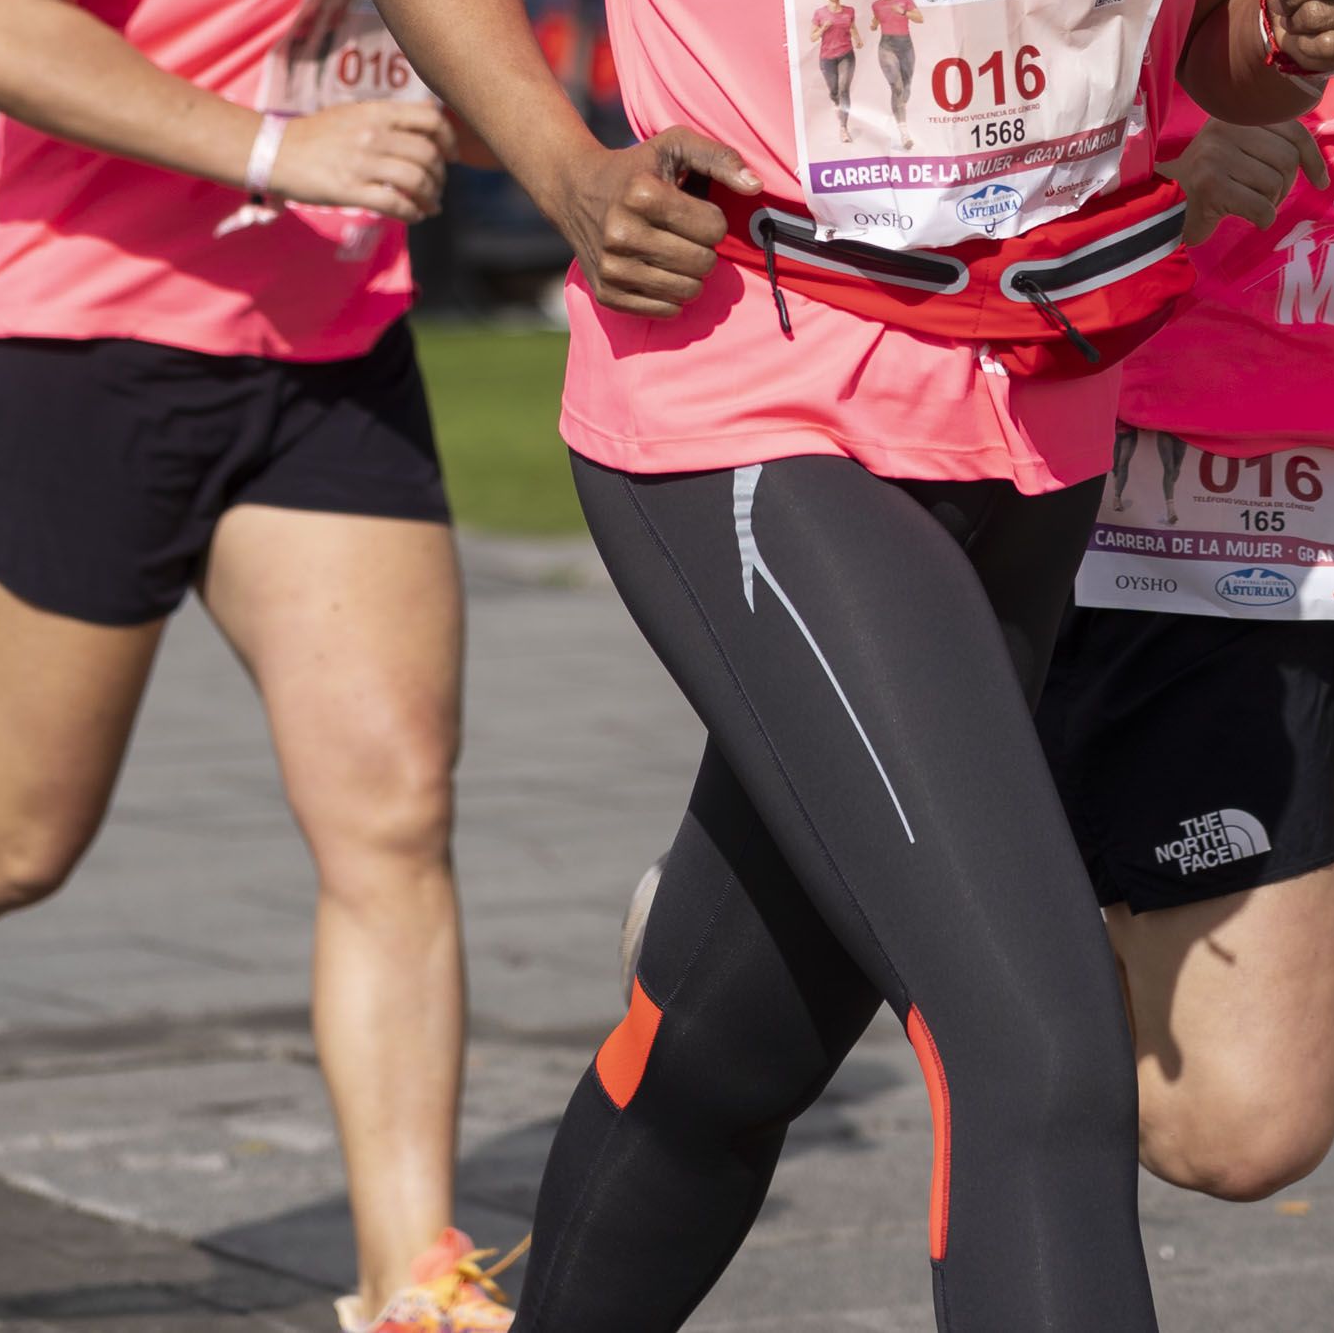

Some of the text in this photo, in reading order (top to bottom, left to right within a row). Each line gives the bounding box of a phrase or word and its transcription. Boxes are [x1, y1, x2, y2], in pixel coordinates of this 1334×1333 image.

[338, 49, 411, 90] 016
[931, 44, 1047, 113] 016
[970, 117, 1026, 148] 1568
[819, 129, 1117, 188] CARRERA DE LA MUJER GRAN CANARIA
[1198, 450, 1324, 503] 016
[1240, 509, 1286, 532] 165
[1094, 529, 1167, 553] CARRERA
[1171, 537, 1194, 554] DE
[1198, 539, 1220, 556] LA
[1225, 540, 1283, 558] MUJER
[1115, 574, 1178, 594] OYSHO
[1221, 579, 1291, 598] ASTURIANA
[1179, 811, 1222, 837] THE
[1154, 827, 1228, 864] NORTH
[1178, 845, 1233, 875] FACE
